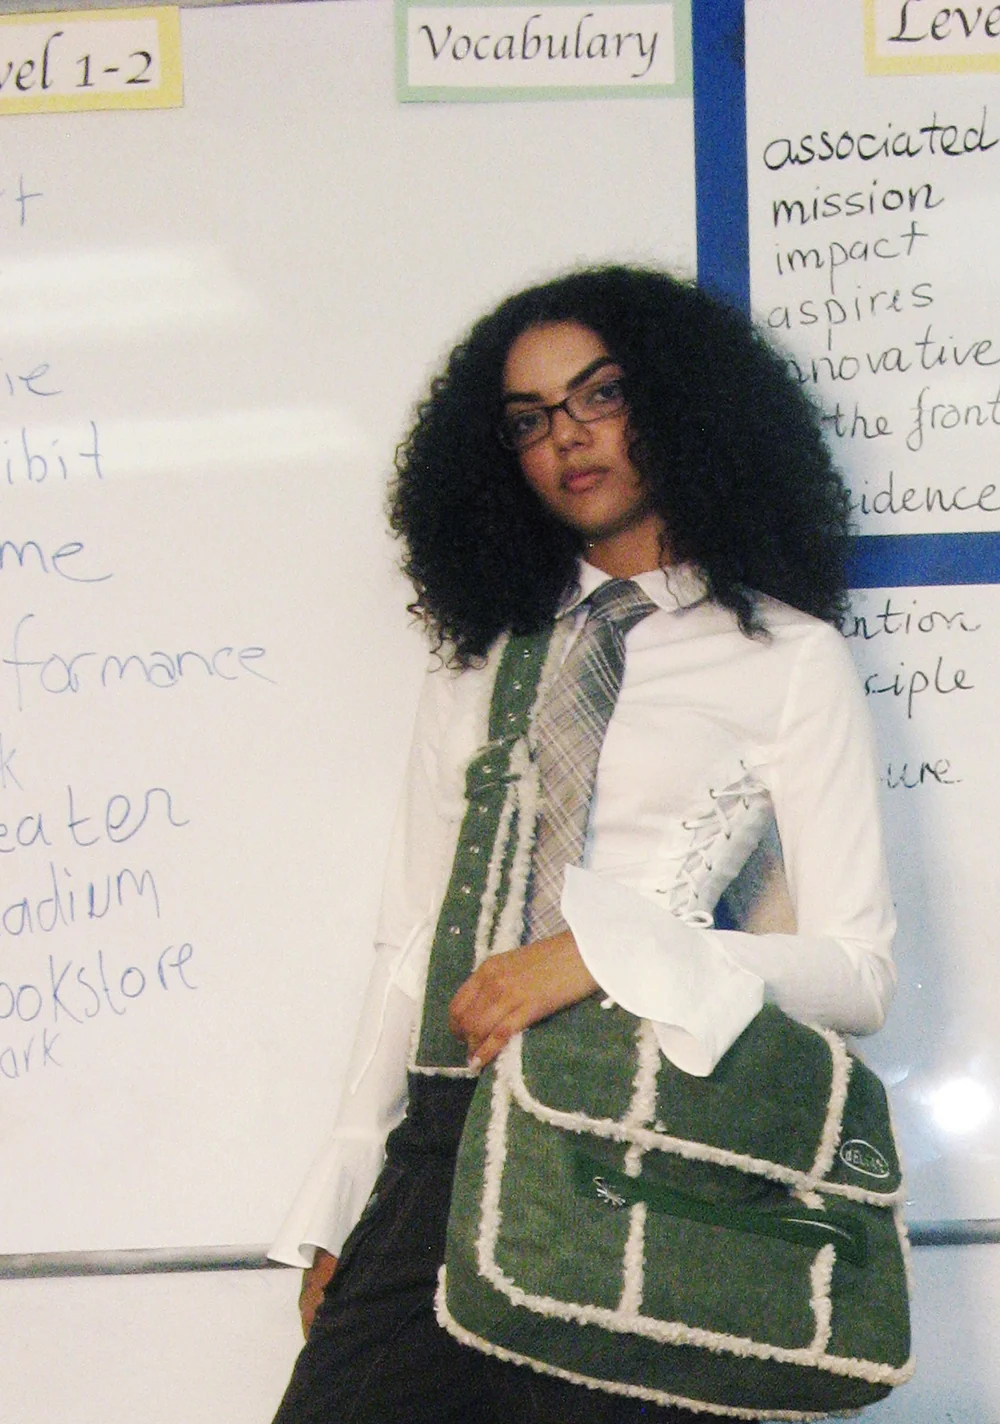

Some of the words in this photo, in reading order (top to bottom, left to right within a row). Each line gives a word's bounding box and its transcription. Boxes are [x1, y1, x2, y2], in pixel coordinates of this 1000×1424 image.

[76, 51, 152, 87] 1-2
[420, 14, 658, 77] Vocabulary
[763, 105, 1000, 170] associated
[773, 179, 945, 227] mission
[775, 220, 929, 295] impact
[820, 402, 894, 440] the
[1, 613, 278, 712] formance
